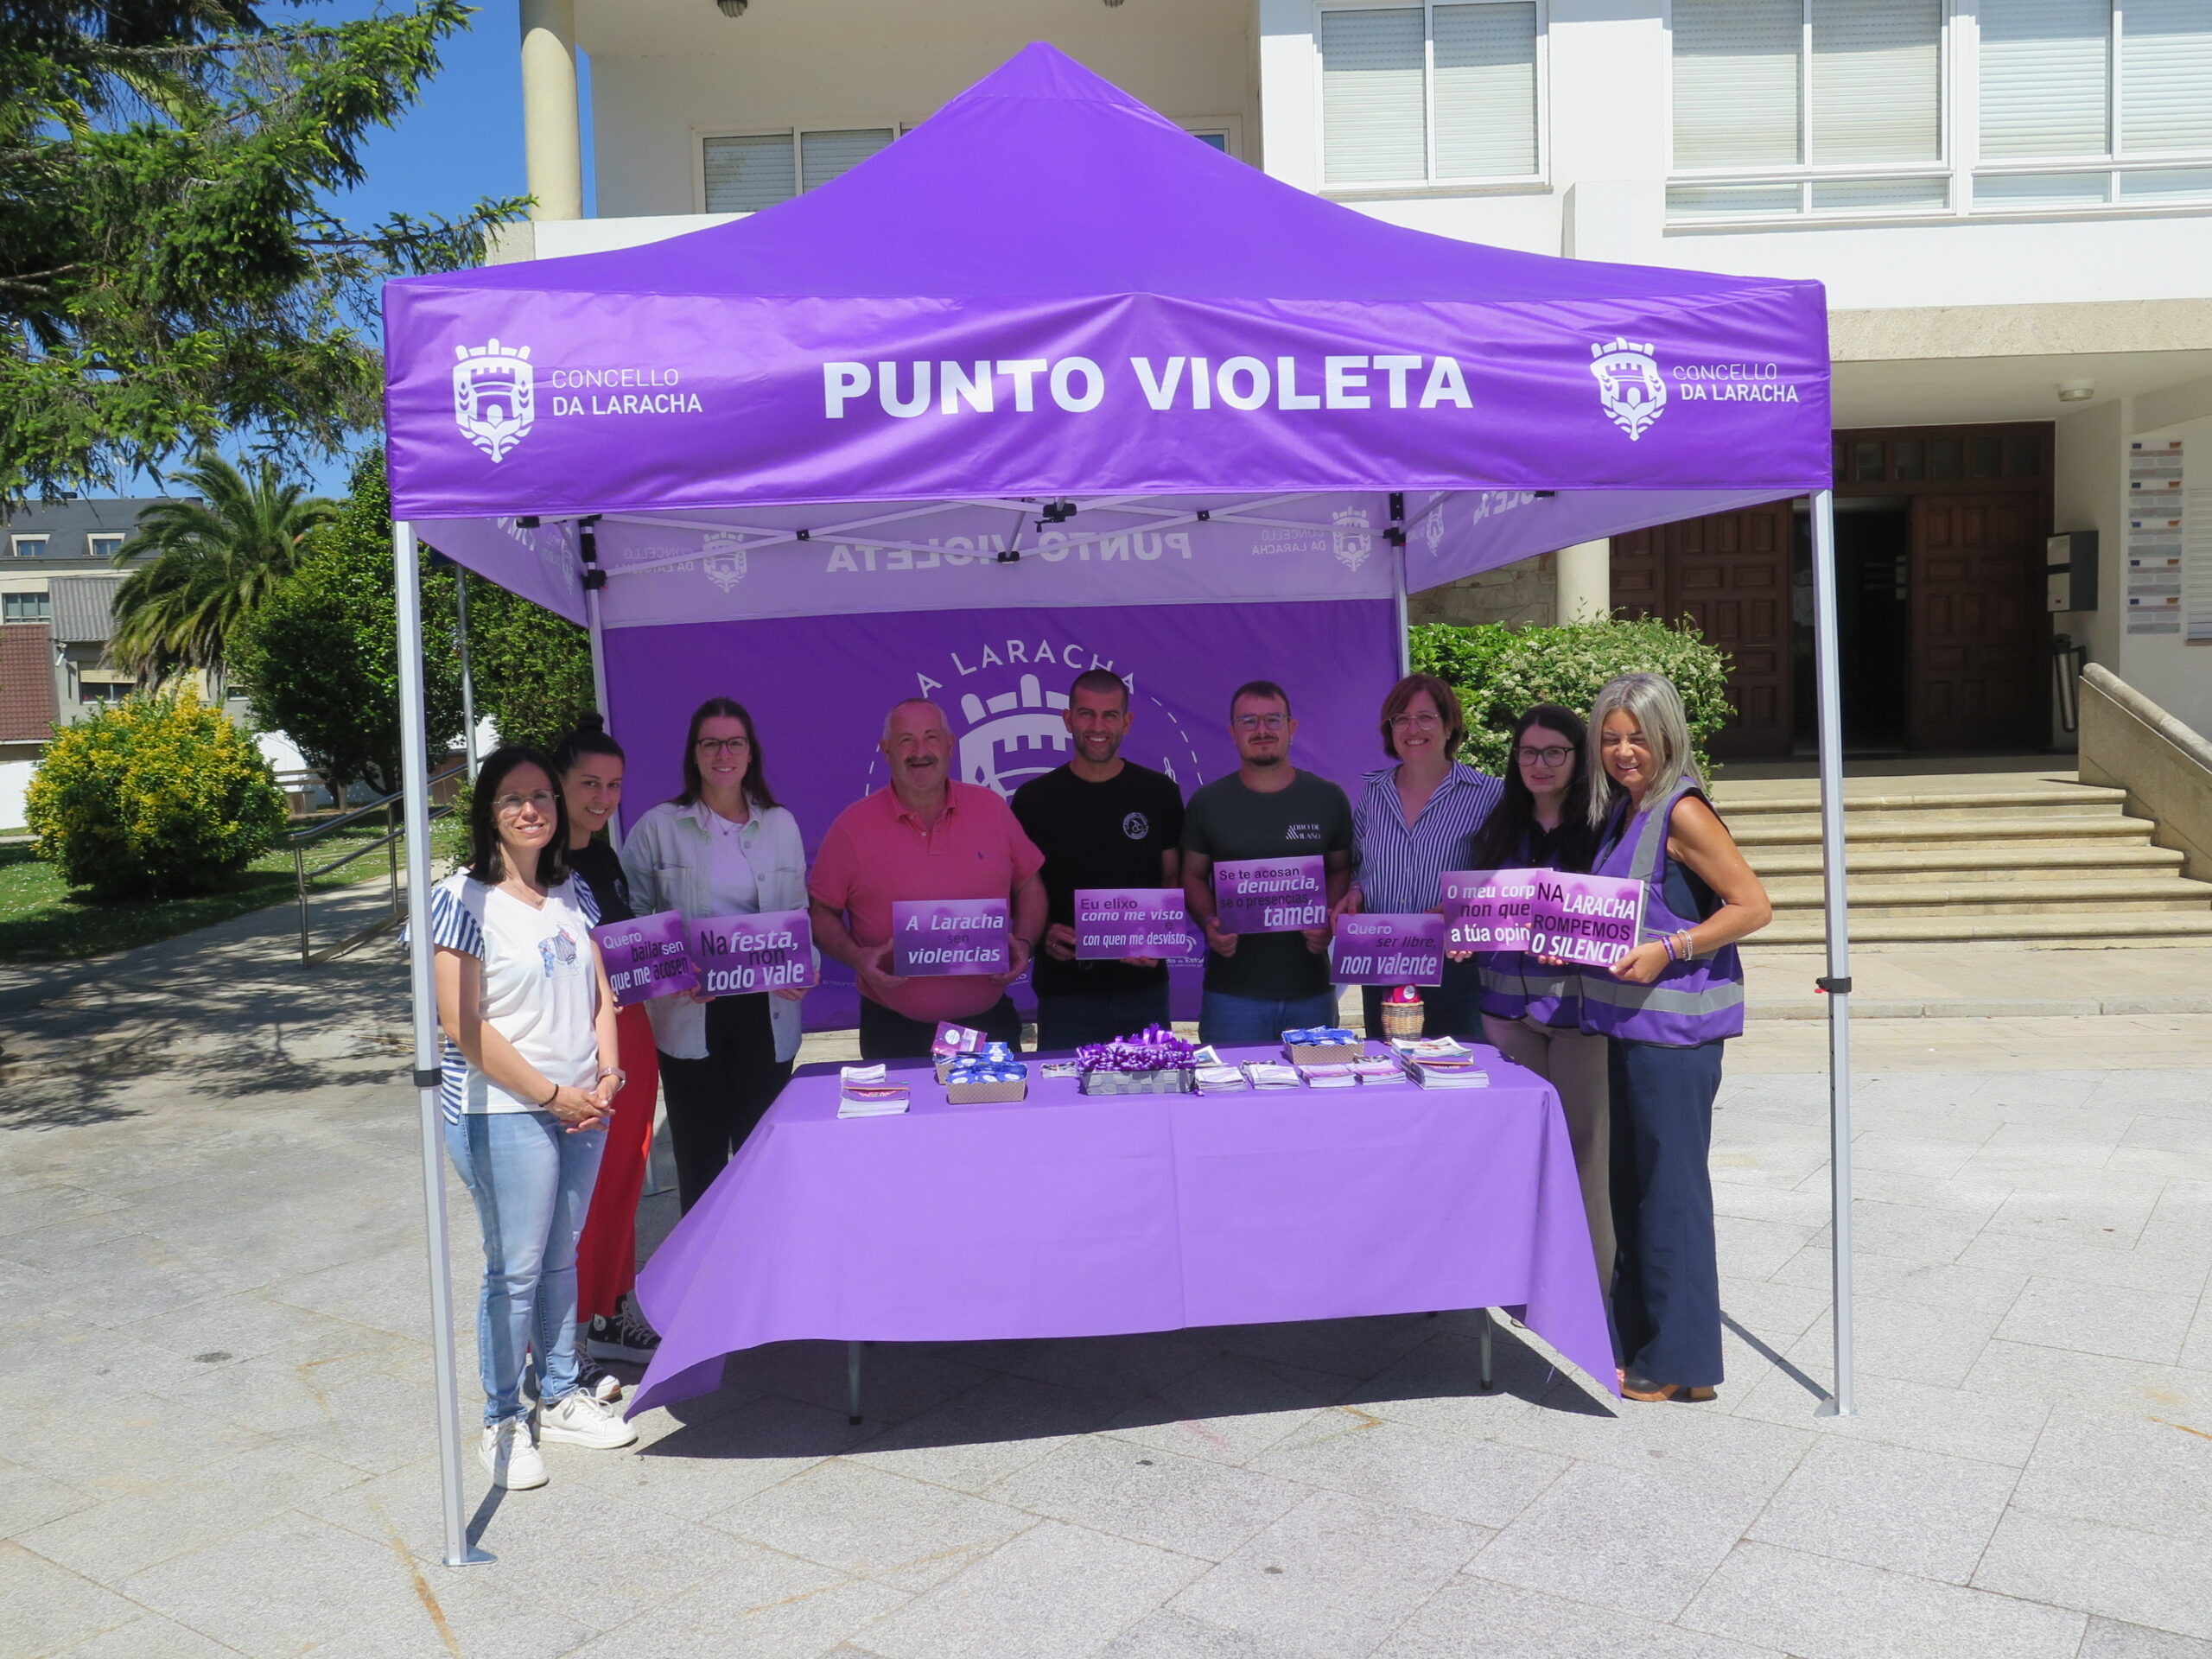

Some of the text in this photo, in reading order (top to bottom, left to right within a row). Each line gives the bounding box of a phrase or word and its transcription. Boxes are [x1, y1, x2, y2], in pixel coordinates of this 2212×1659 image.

[551, 367, 679, 389] CONCELLO
[1673, 363, 1777, 380] CONCELLO
[823, 354, 1474, 419] PUNTO VIOLETA
[1680, 383, 1800, 403] DA LARACHA
[552, 393, 703, 416] DA LARACHA
[917, 639, 1135, 699] A LARACHA
[1219, 868, 1300, 881] Se te acosan
[1237, 875, 1319, 894] denuncia,
[1447, 884, 1535, 900] O meu corp
[1081, 898, 1138, 910] Eu elixo
[1220, 899, 1234, 908] se
[1236, 898, 1243, 907] o
[1460, 902, 1530, 919] non que
[1537, 882, 1635, 920] NA LARACHA
[906, 913, 1004, 931] A Laracha
[1082, 909, 1184, 922] como me visto
[1264, 899, 1326, 927] tamén
[1165, 921, 1174, 931] e
[1347, 923, 1392, 935] Quero
[1451, 923, 1530, 946] a túa opin
[1533, 914, 1630, 941] ROMPEMOS
[603, 931, 642, 950] Quero
[701, 930, 798, 957] Na festa,
[947, 933, 969, 944] sen
[1083, 931, 1185, 949] con quen me desvisto
[1376, 937, 1399, 948] ser
[1531, 932, 1546, 954] O
[631, 939, 683, 963] bailar sen
[748, 946, 785, 966] non
[907, 946, 1001, 964] violencias
[1340, 952, 1437, 976] non valente
[610, 957, 689, 995] que me acosen
[707, 959, 804, 992] todo vale
